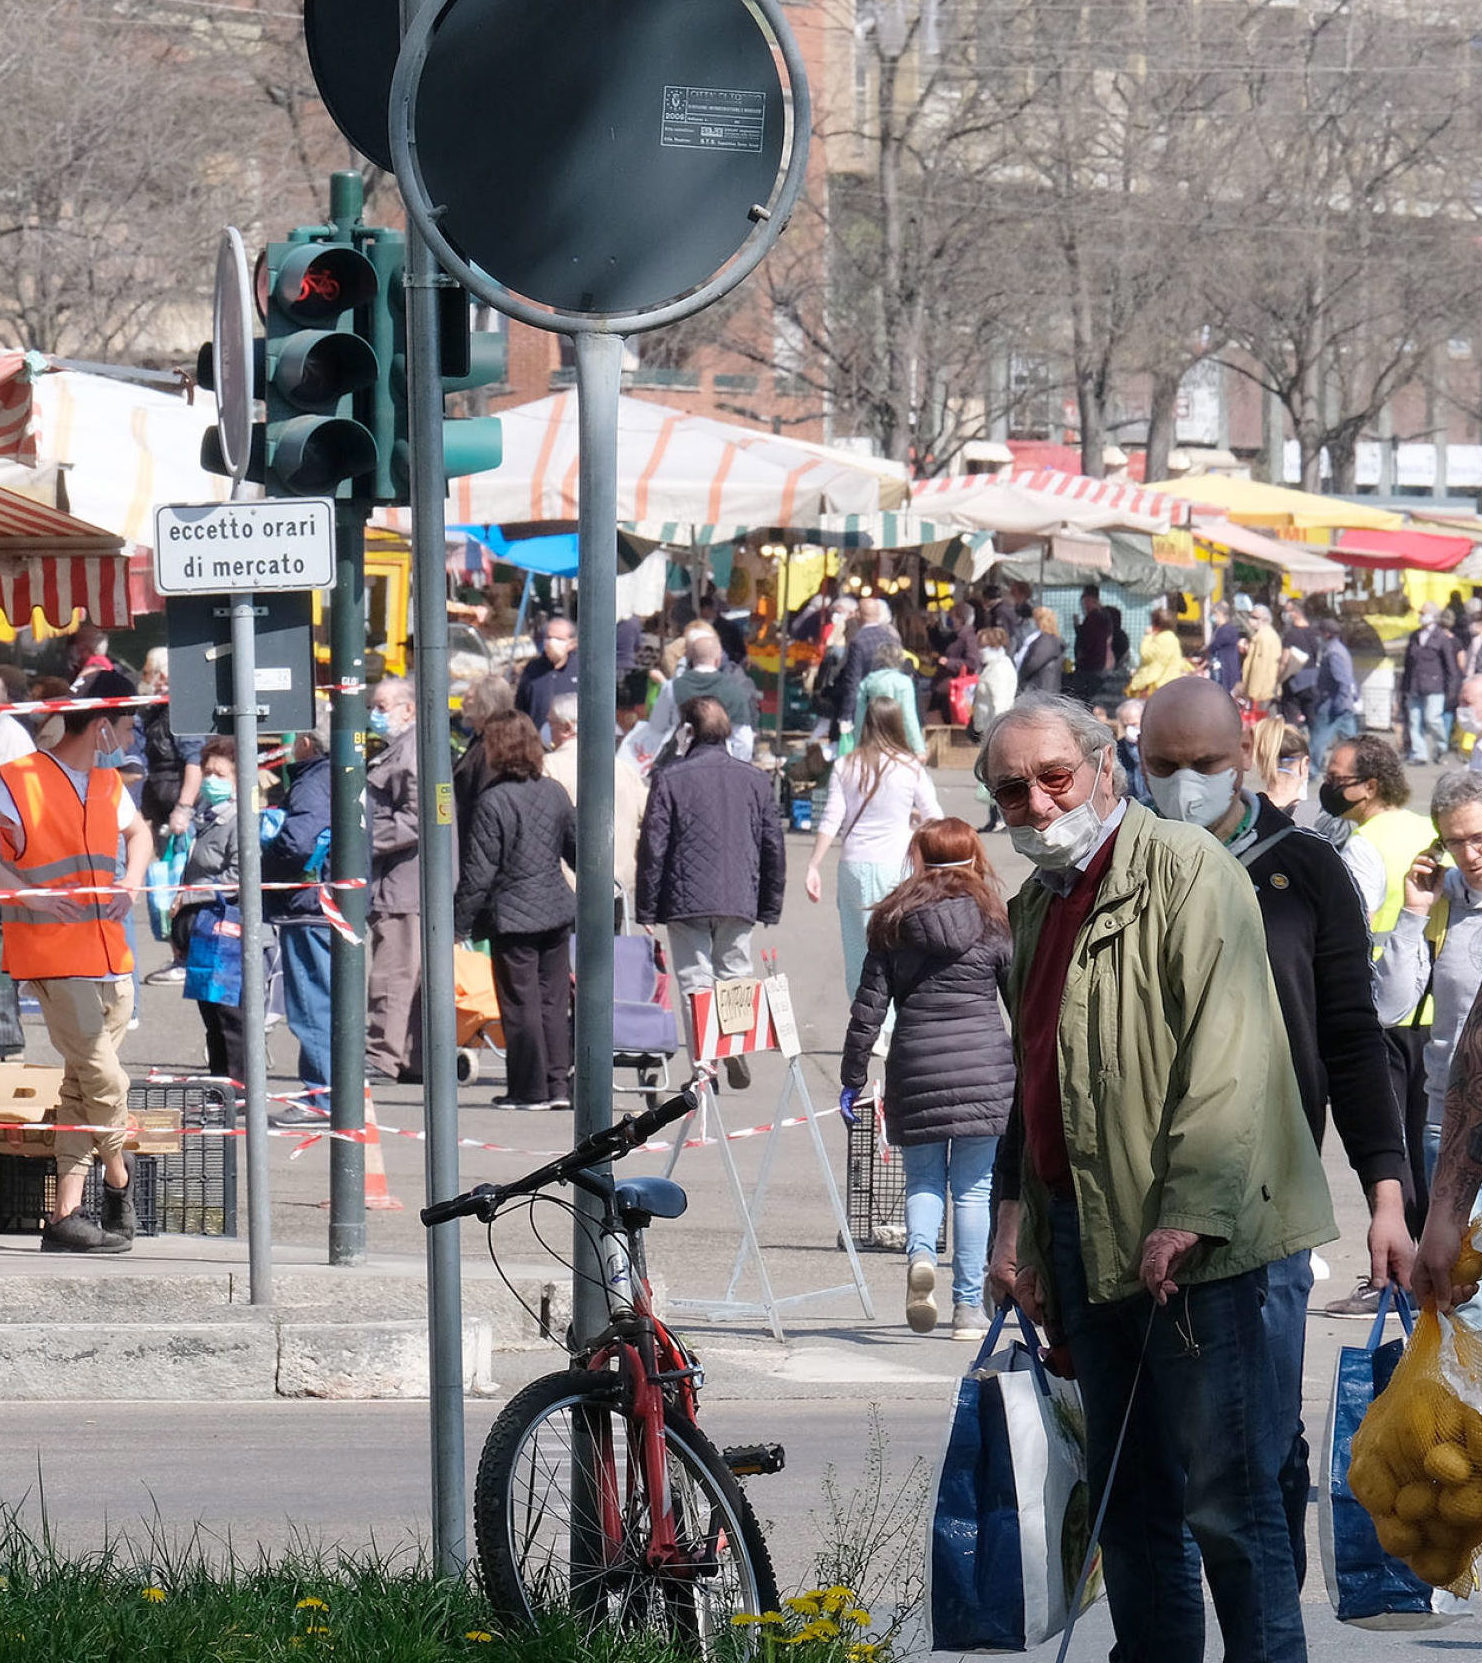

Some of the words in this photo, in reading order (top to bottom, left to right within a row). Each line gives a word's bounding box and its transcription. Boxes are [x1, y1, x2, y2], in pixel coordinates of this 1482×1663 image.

[169, 518, 253, 541] eccetto
[262, 513, 316, 537] orari
[183, 556, 203, 578] di
[212, 553, 305, 577] mercato
